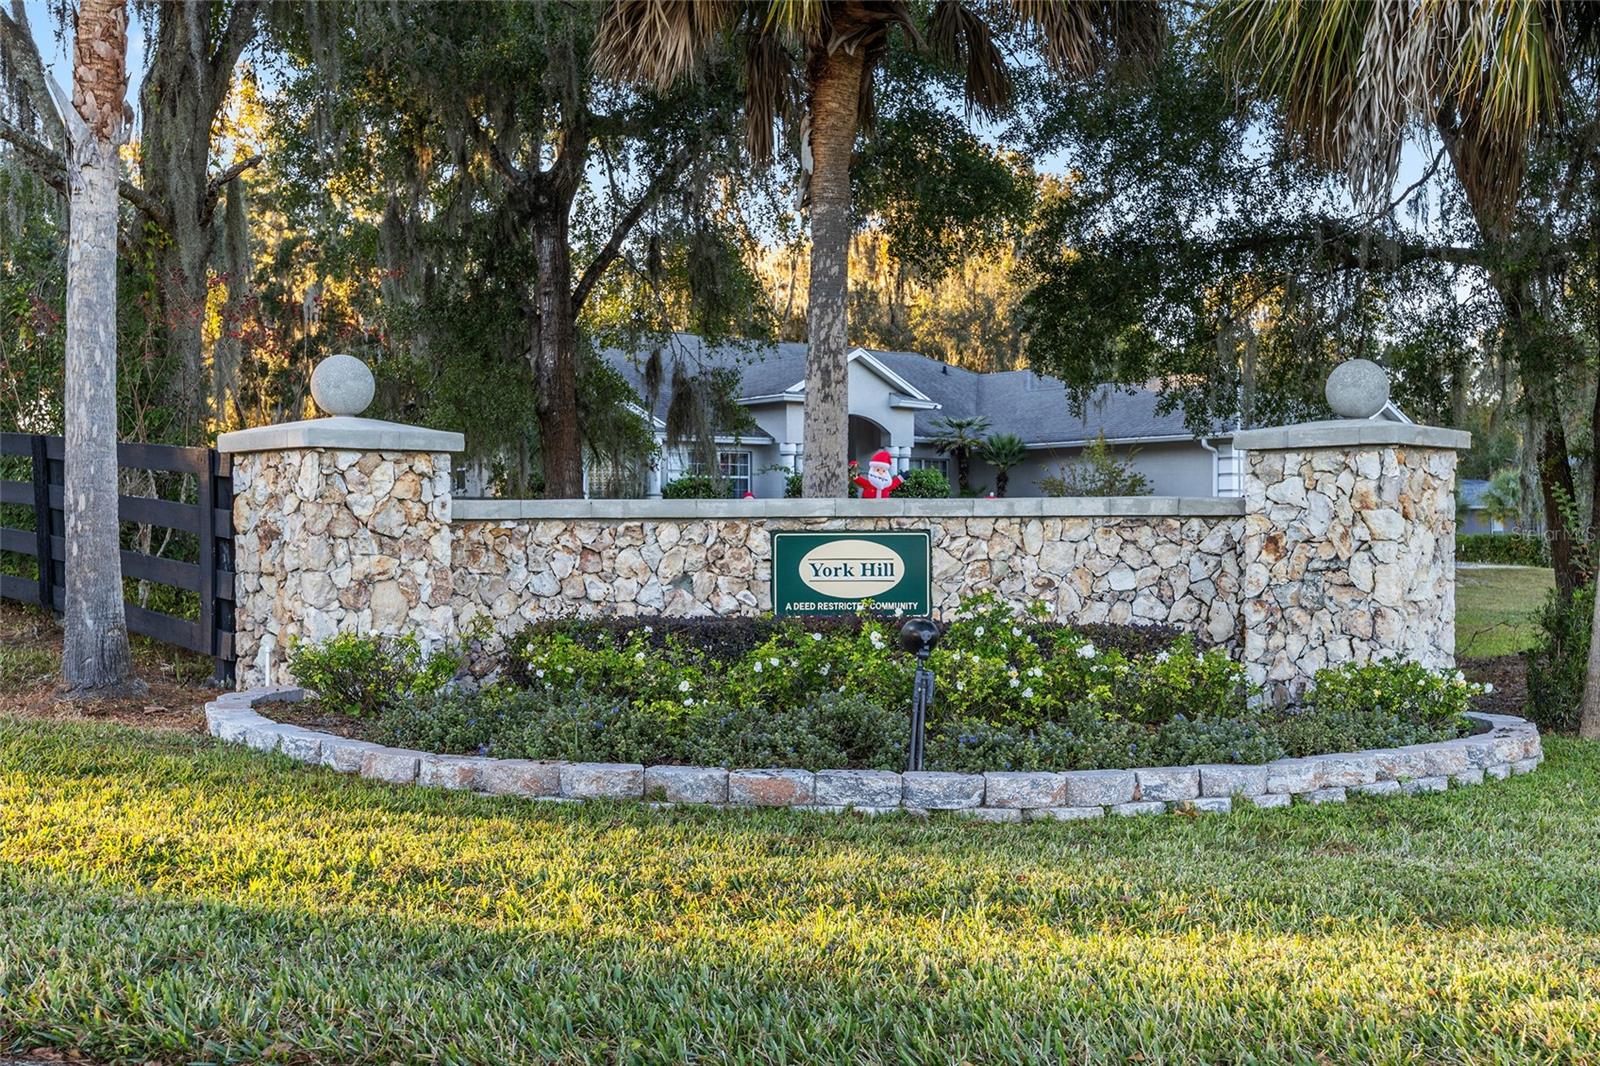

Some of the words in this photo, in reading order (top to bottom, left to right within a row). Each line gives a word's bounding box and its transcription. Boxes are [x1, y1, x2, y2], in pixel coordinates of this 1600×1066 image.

[809, 563, 855, 577] York
[860, 563, 895, 577] Hill
[785, 602, 793, 610] A
[793, 602, 816, 610] DEED
[870, 602, 918, 610] COMMUNITY
